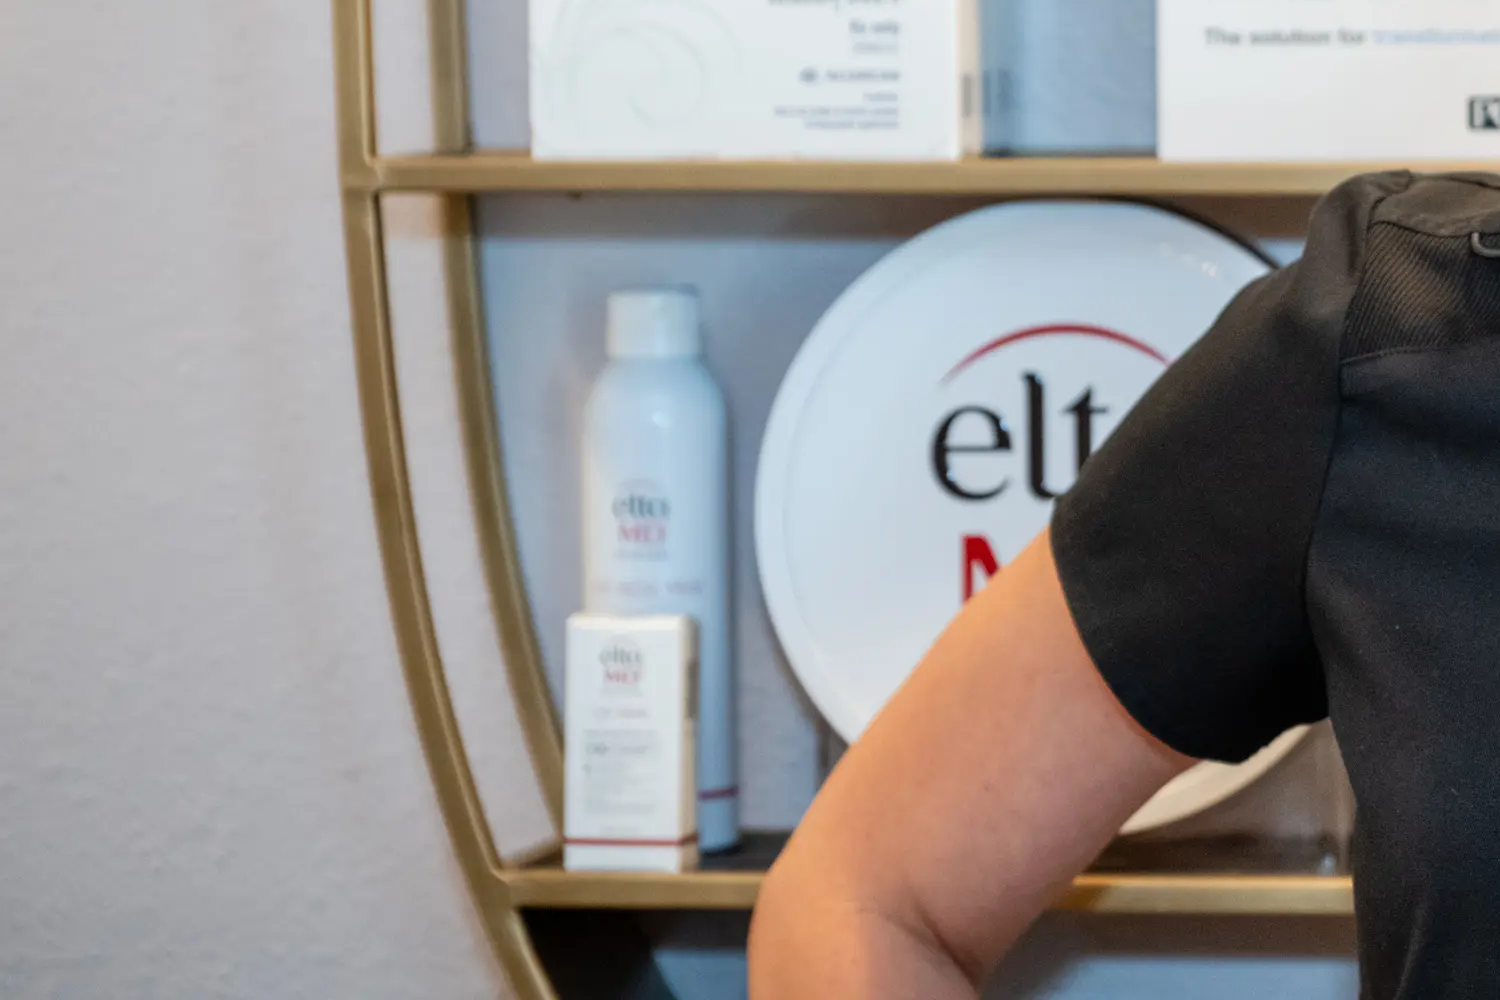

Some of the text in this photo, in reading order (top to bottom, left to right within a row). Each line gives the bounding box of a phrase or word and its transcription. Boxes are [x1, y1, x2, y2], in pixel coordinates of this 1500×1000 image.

[1204, 27, 1240, 46] The
[1249, 27, 1330, 46] solution
[1337, 27, 1366, 46] for
[930, 369, 1108, 500] elt
